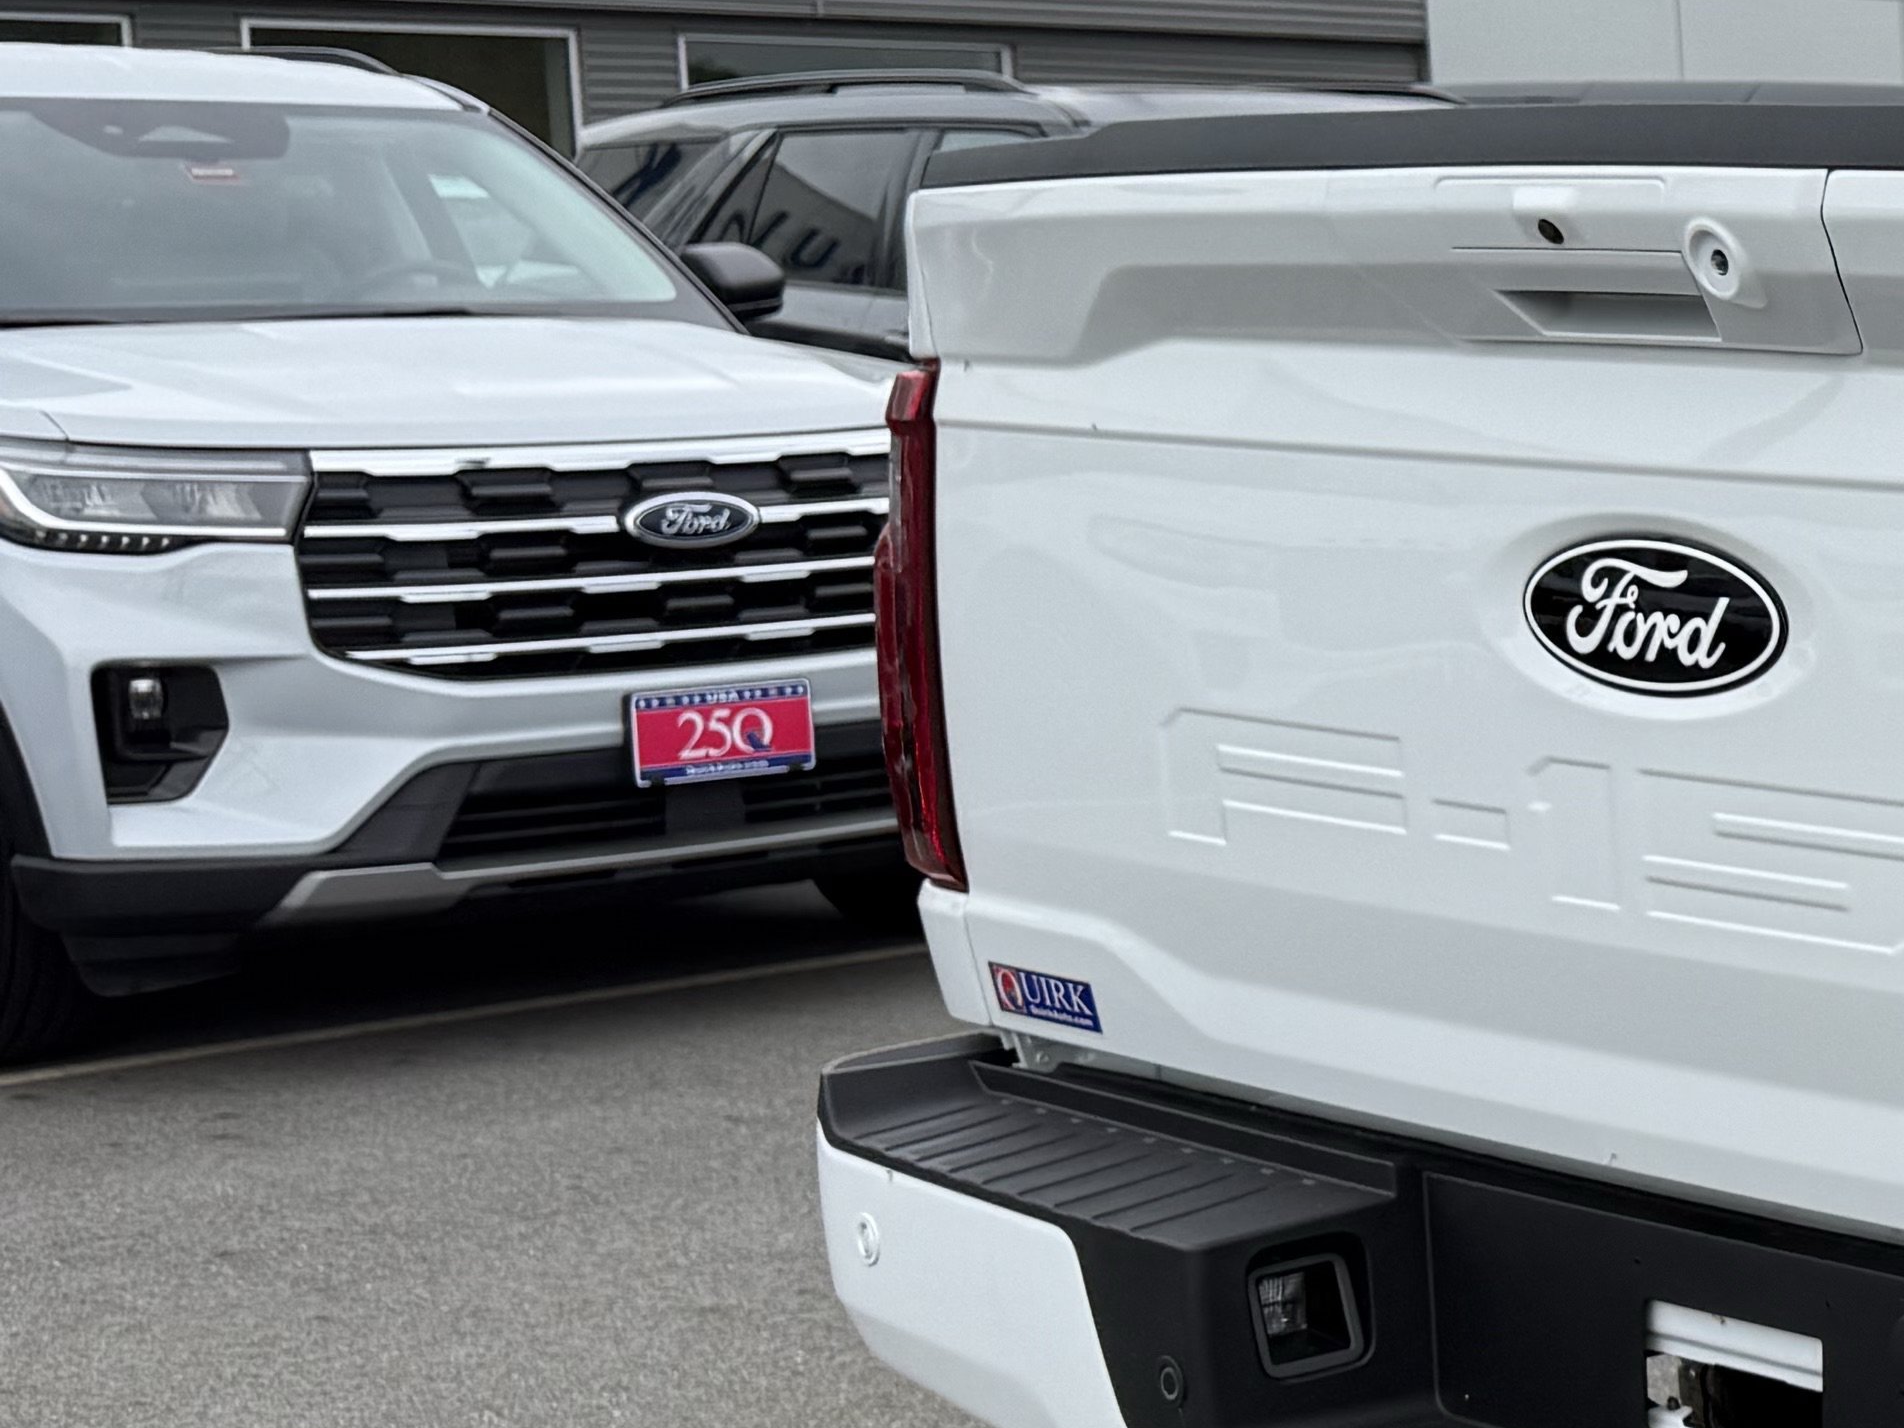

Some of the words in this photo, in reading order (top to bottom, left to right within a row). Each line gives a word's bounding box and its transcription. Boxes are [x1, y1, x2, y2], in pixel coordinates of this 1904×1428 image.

[660, 503, 731, 535] Ford
[1566, 557, 1730, 669] Ford
[995, 968, 1094, 1016] QUIRK
